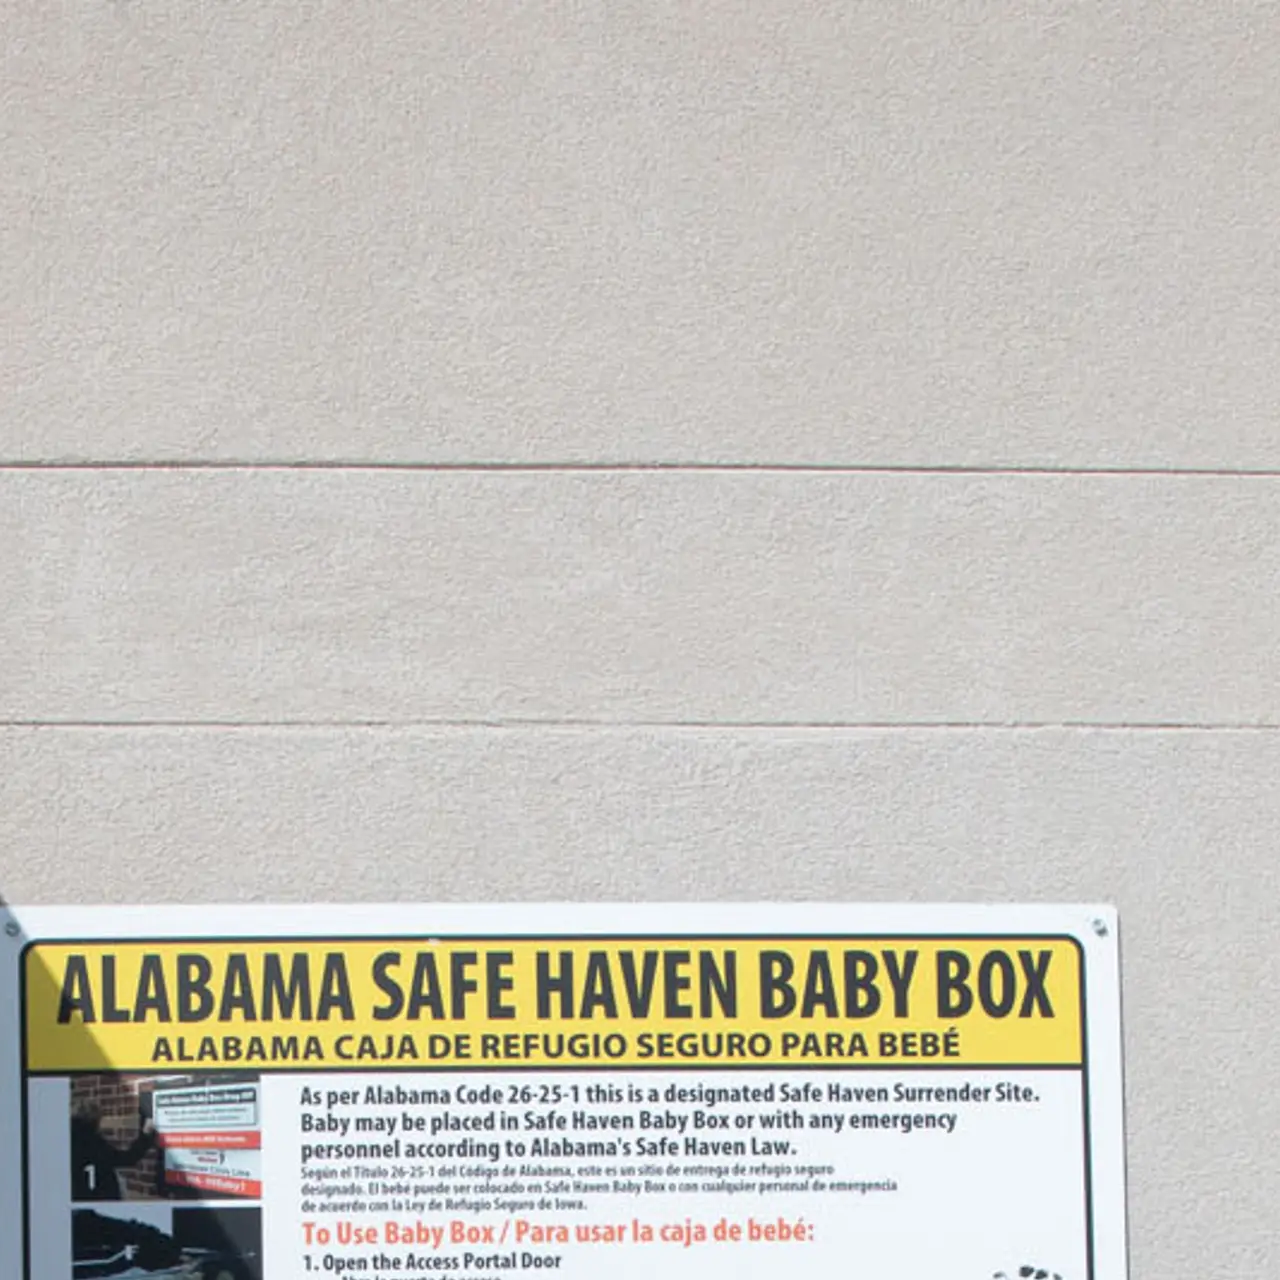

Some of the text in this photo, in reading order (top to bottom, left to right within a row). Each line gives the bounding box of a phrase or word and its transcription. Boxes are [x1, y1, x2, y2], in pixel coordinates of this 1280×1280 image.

[57, 950, 1055, 1023] ALABAMA SAFE HAVEN BABY BOX
[152, 1027, 960, 1062] ALABAMA CAJA DE REFUGIO SEGURO PARA BEBÉ
[300, 1082, 1039, 1110] As per Alabama Code 26-25-1 this is a designated Safe Haven Surrender Site.
[301, 1109, 957, 1136] Baby may be placed in Safe Haven Baby Box or with any emergency
[301, 1137, 797, 1164] personnel according to Alabama's Safe Haven Law.
[84, 1164, 97, 1190] 1
[302, 1222, 330, 1245] To
[337, 1222, 378, 1245] Use
[385, 1220, 444, 1249] Baby
[450, 1220, 494, 1244] Box
[515, 1220, 569, 1243] Para
[575, 1225, 627, 1243] usar
[632, 1219, 653, 1242] la
[660, 1218, 706, 1247] caja
[713, 1218, 742, 1241] de
[748, 1218, 813, 1241] bebé:
[304, 1252, 561, 1275] 1. Open the Access Portal Door
